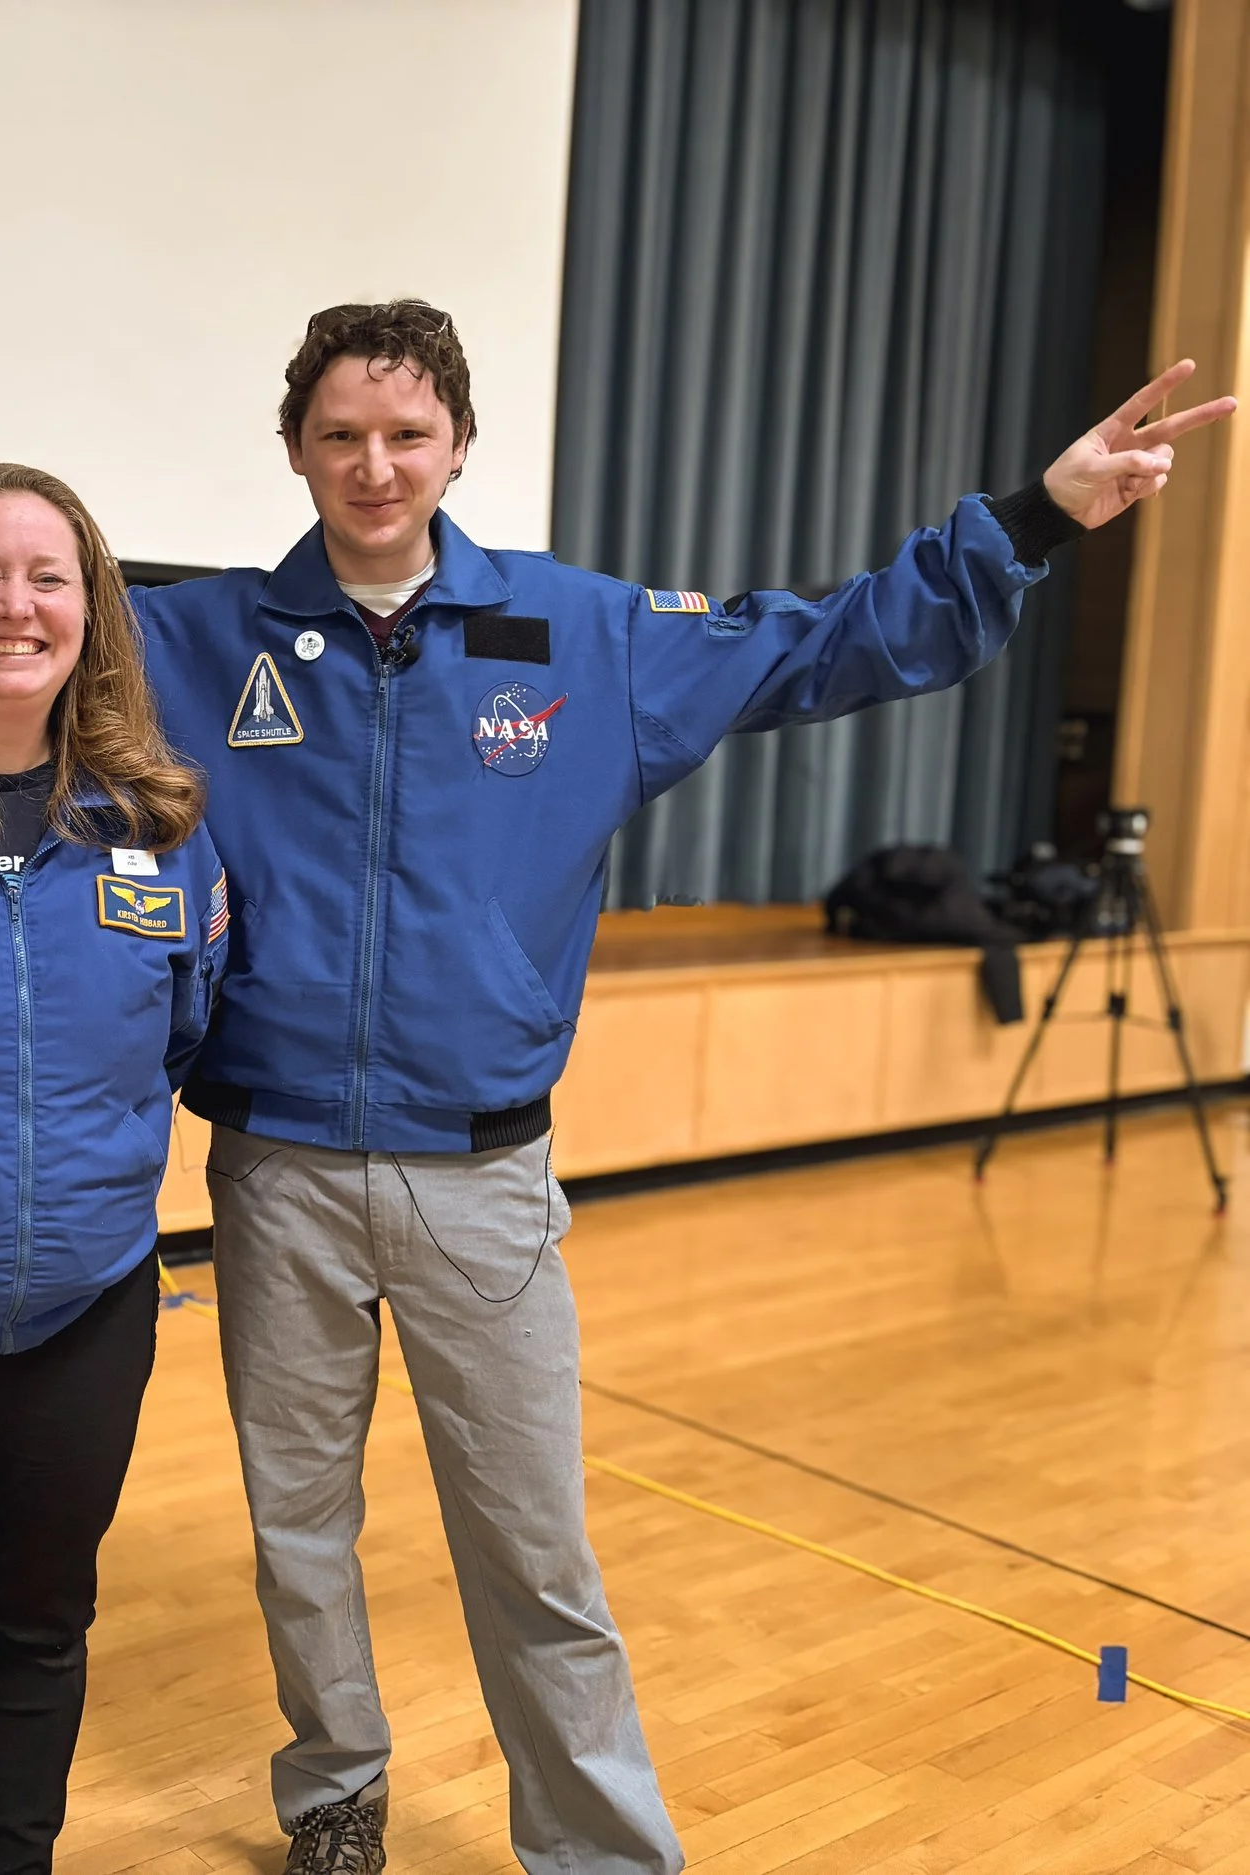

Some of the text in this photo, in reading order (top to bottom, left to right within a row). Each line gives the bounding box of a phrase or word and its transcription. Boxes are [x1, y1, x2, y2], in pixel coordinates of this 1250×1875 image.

[237, 727, 292, 739] SPACE SHUTTLE
[478, 717, 549, 741] NASA
